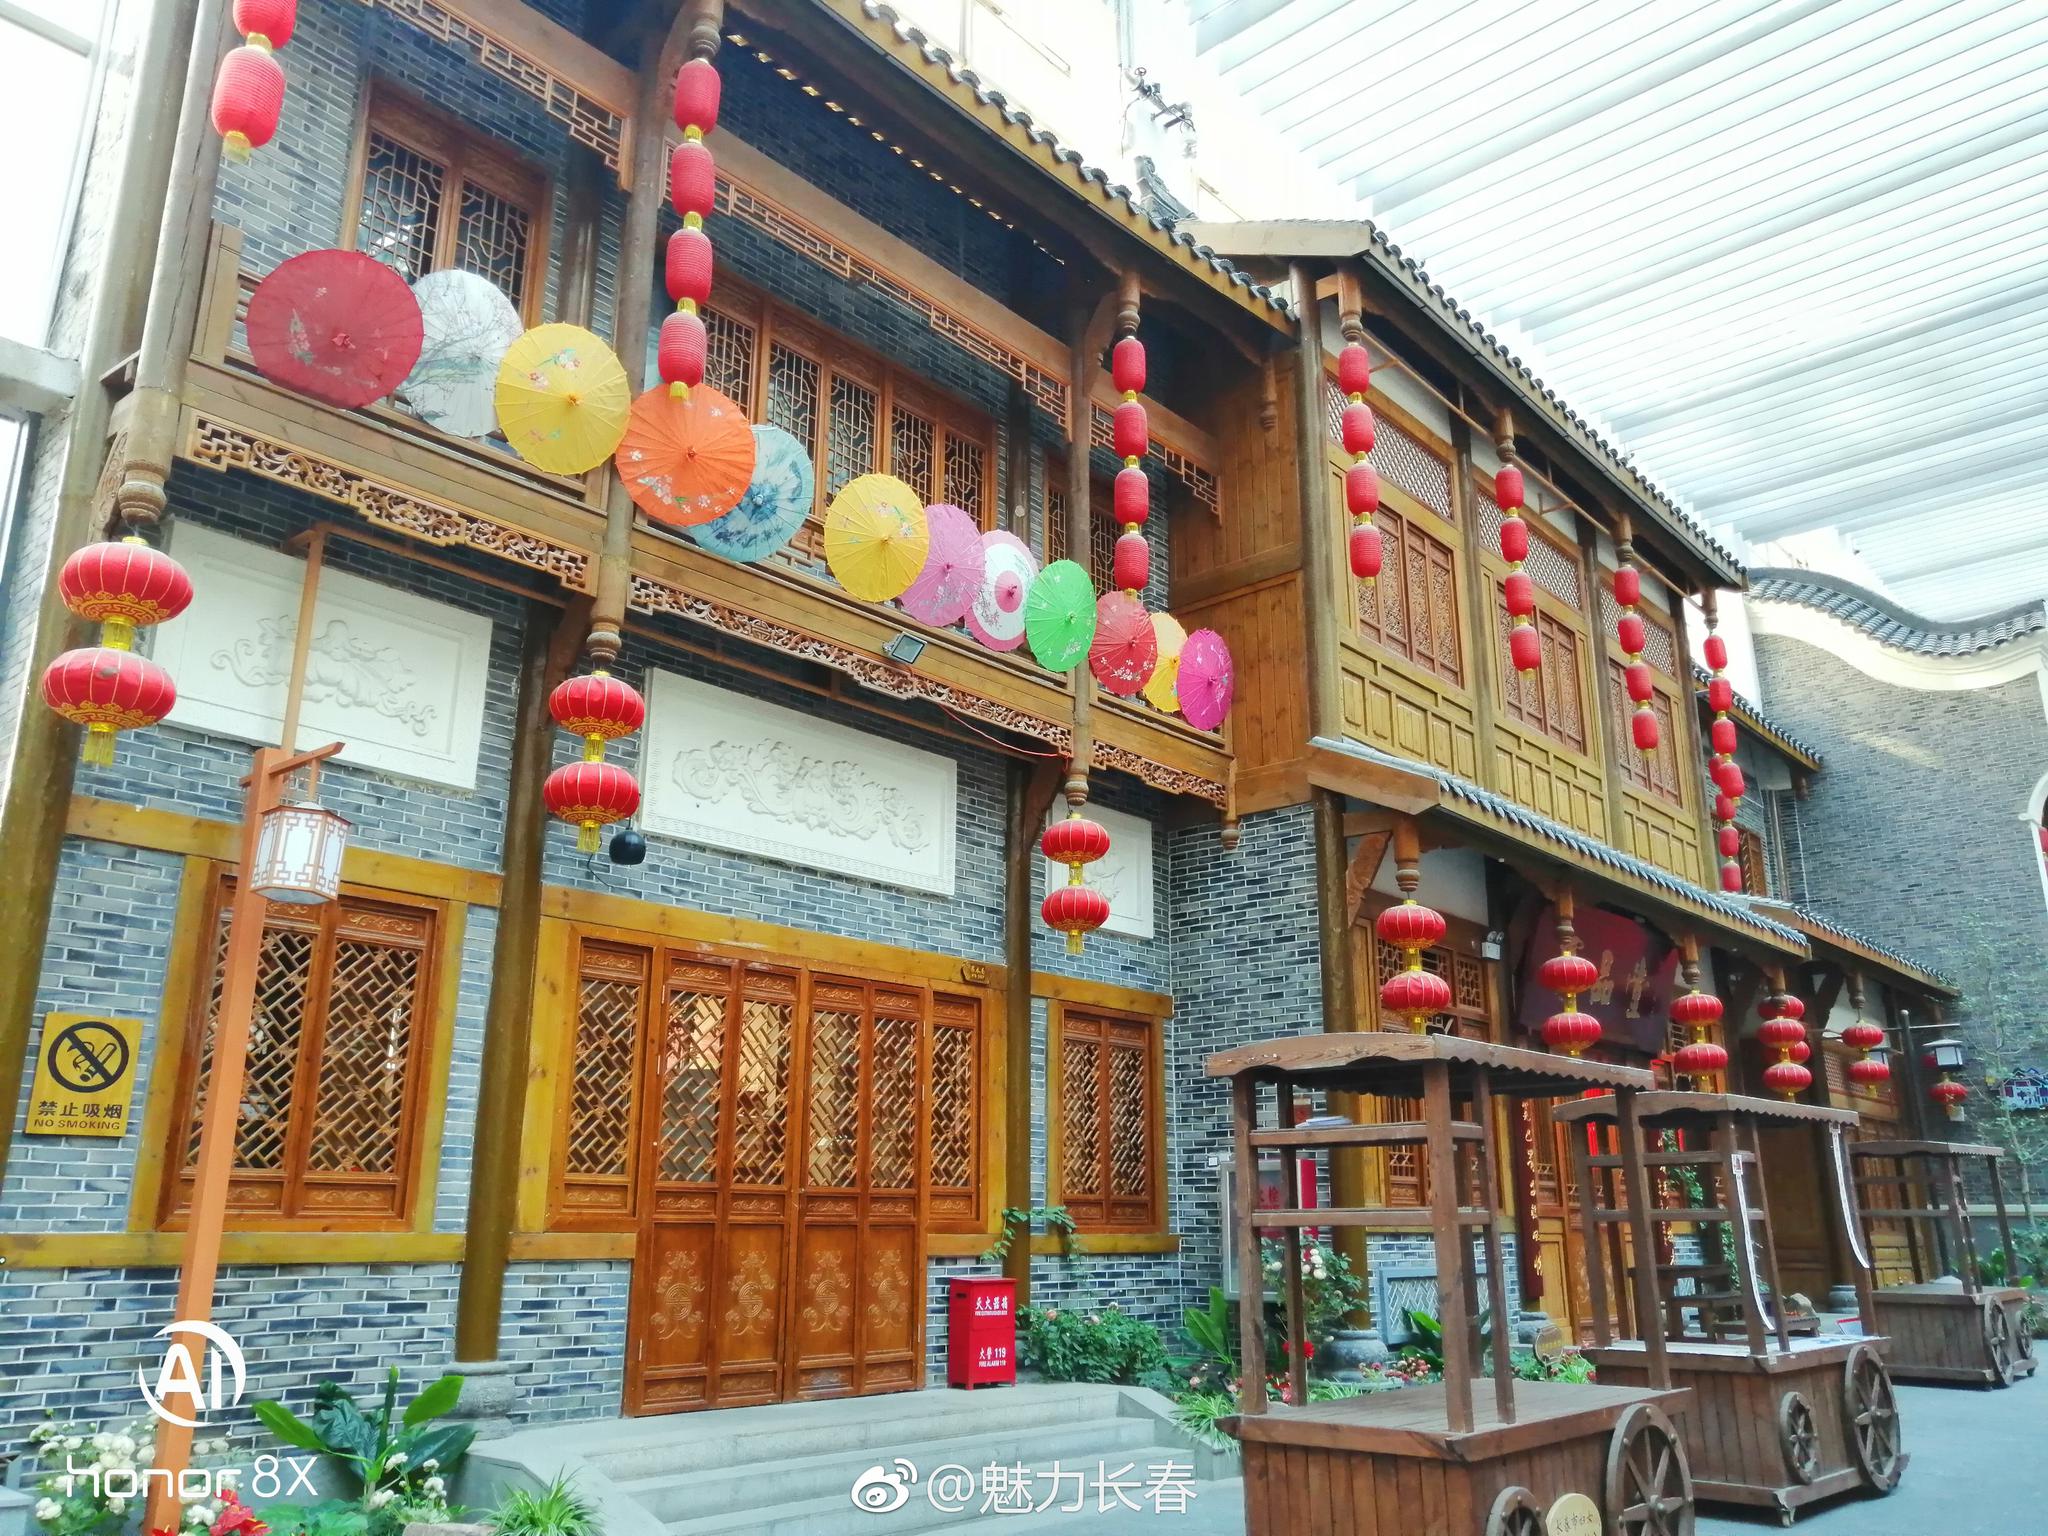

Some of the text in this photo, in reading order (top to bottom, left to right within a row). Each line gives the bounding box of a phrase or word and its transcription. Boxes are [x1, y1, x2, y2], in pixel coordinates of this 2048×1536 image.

[38, 1100, 122, 1119] 禁止吸烟
[34, 1119, 120, 1130] NO SMOKING
[975, 1296, 1008, 1310] 灭火器箱
[995, 1347, 1006, 1358] 119
